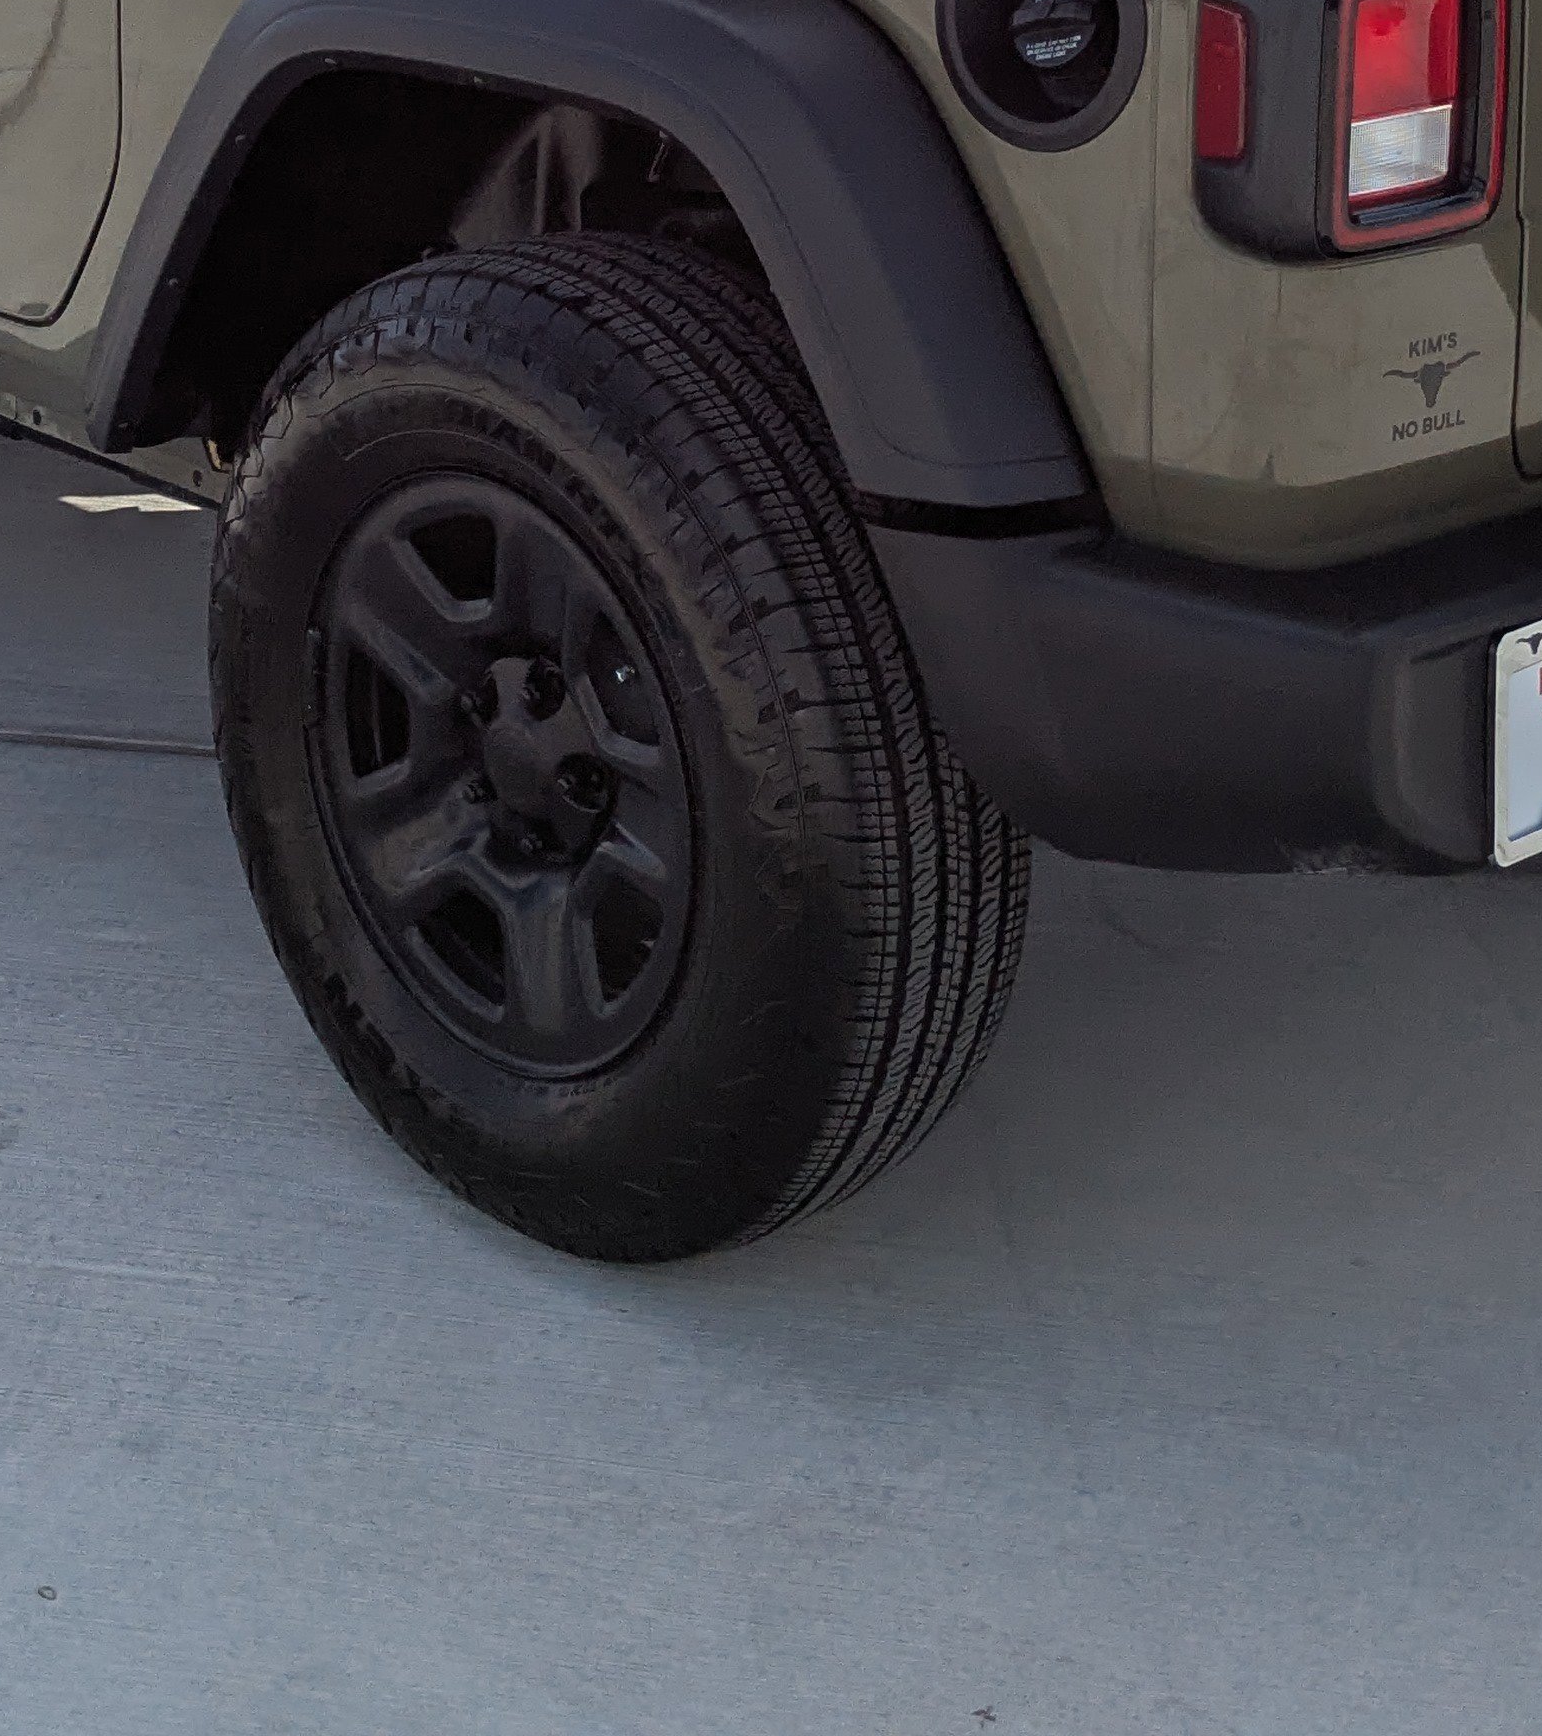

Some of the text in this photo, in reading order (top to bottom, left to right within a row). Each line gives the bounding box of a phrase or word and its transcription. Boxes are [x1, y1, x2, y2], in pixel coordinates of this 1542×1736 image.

[1409, 332, 1458, 358] KIM'S
[1392, 409, 1466, 441] NO BULL
